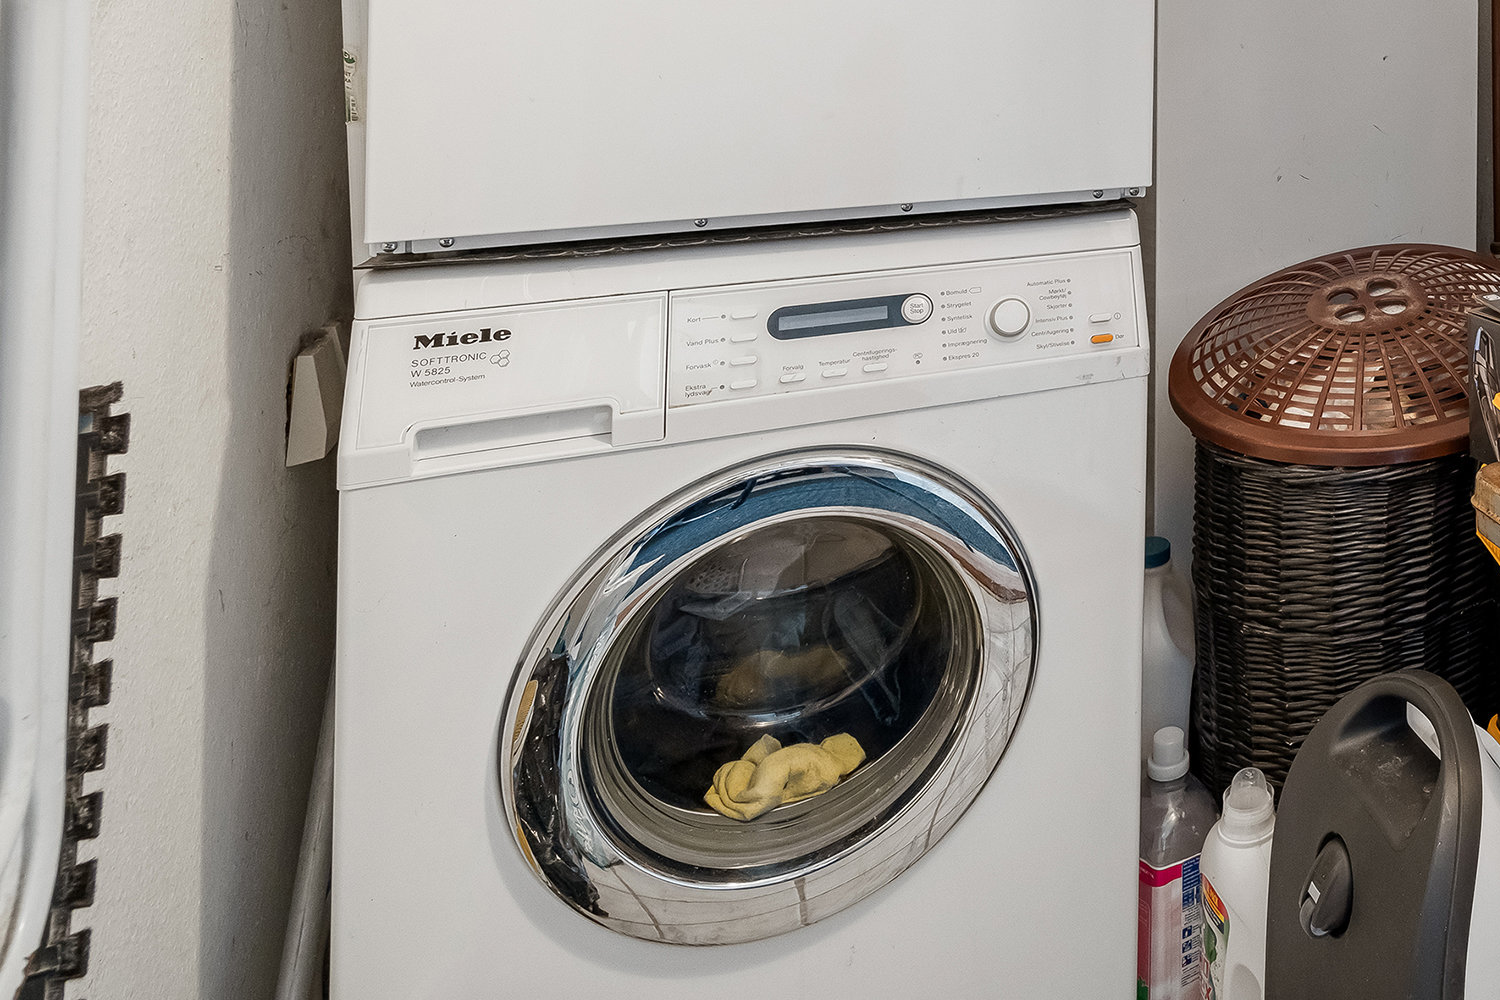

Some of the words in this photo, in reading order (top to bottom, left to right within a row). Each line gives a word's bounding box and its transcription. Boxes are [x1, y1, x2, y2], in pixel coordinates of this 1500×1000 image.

[1026, 279, 1054, 287] Automatic
[412, 328, 512, 350] Miele
[686, 339, 703, 347] Vand
[411, 352, 487, 368] SOFTTRONIC
[818, 358, 851, 367] Temperatur
[685, 363, 712, 371] Forvask
[782, 364, 804, 372] Forvalg
[410, 370, 422, 378] W
[424, 367, 451, 377] 5825
[409, 374, 486, 388] Watercontrol-System
